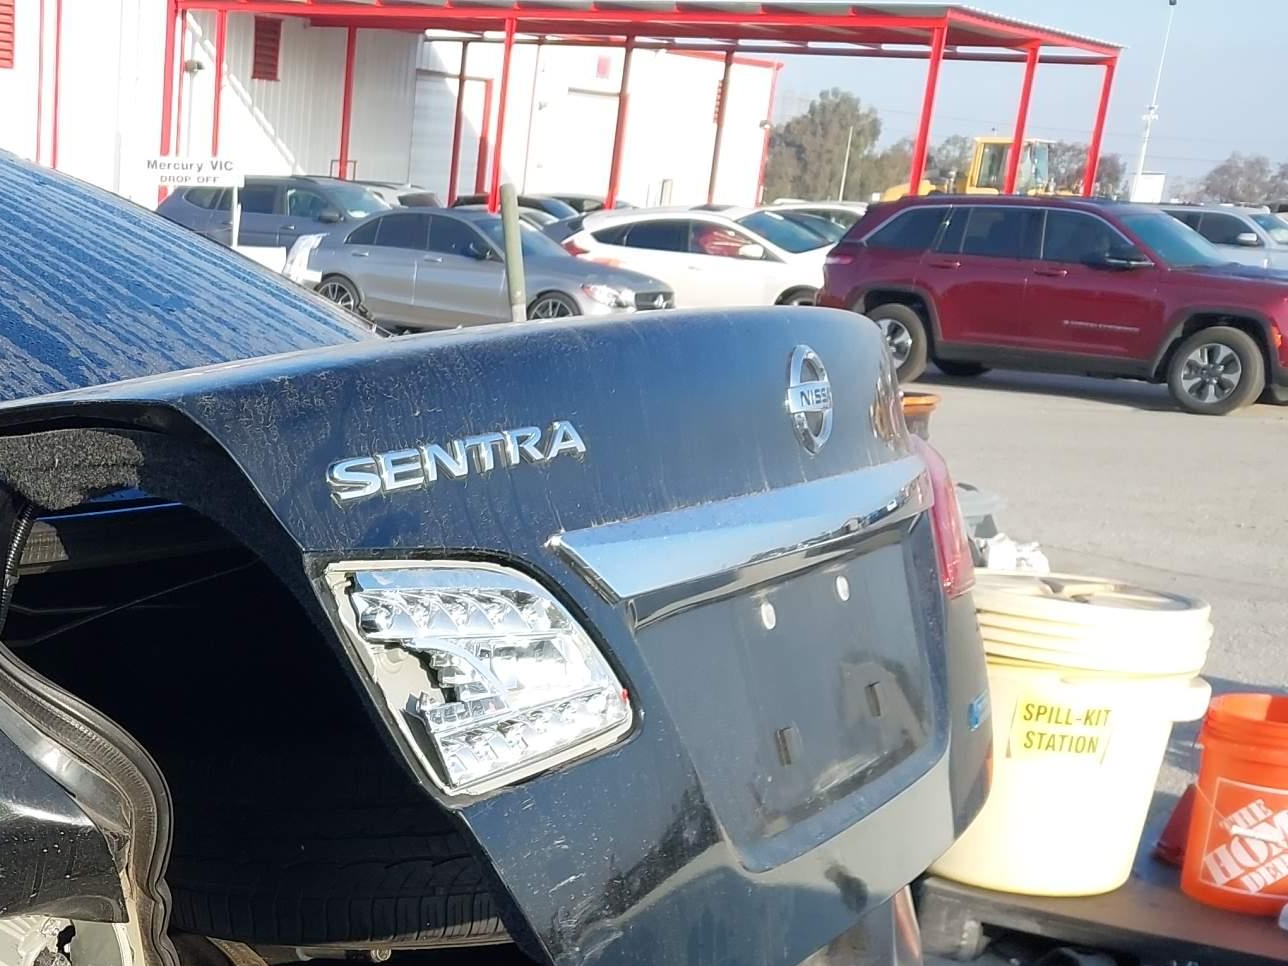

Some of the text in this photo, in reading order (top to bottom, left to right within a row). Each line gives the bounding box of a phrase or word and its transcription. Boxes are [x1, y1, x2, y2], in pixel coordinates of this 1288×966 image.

[147, 160, 234, 172] Mercury VIC
[160, 175, 220, 184] DROP OFF
[800, 387, 830, 407] NISS
[326, 420, 586, 500] SENTRA
[1023, 703, 1112, 726] SPILL-KIT
[1023, 730, 1099, 753] STATION
[1219, 799, 1273, 833] THE
[1205, 810, 1288, 885] HOM
